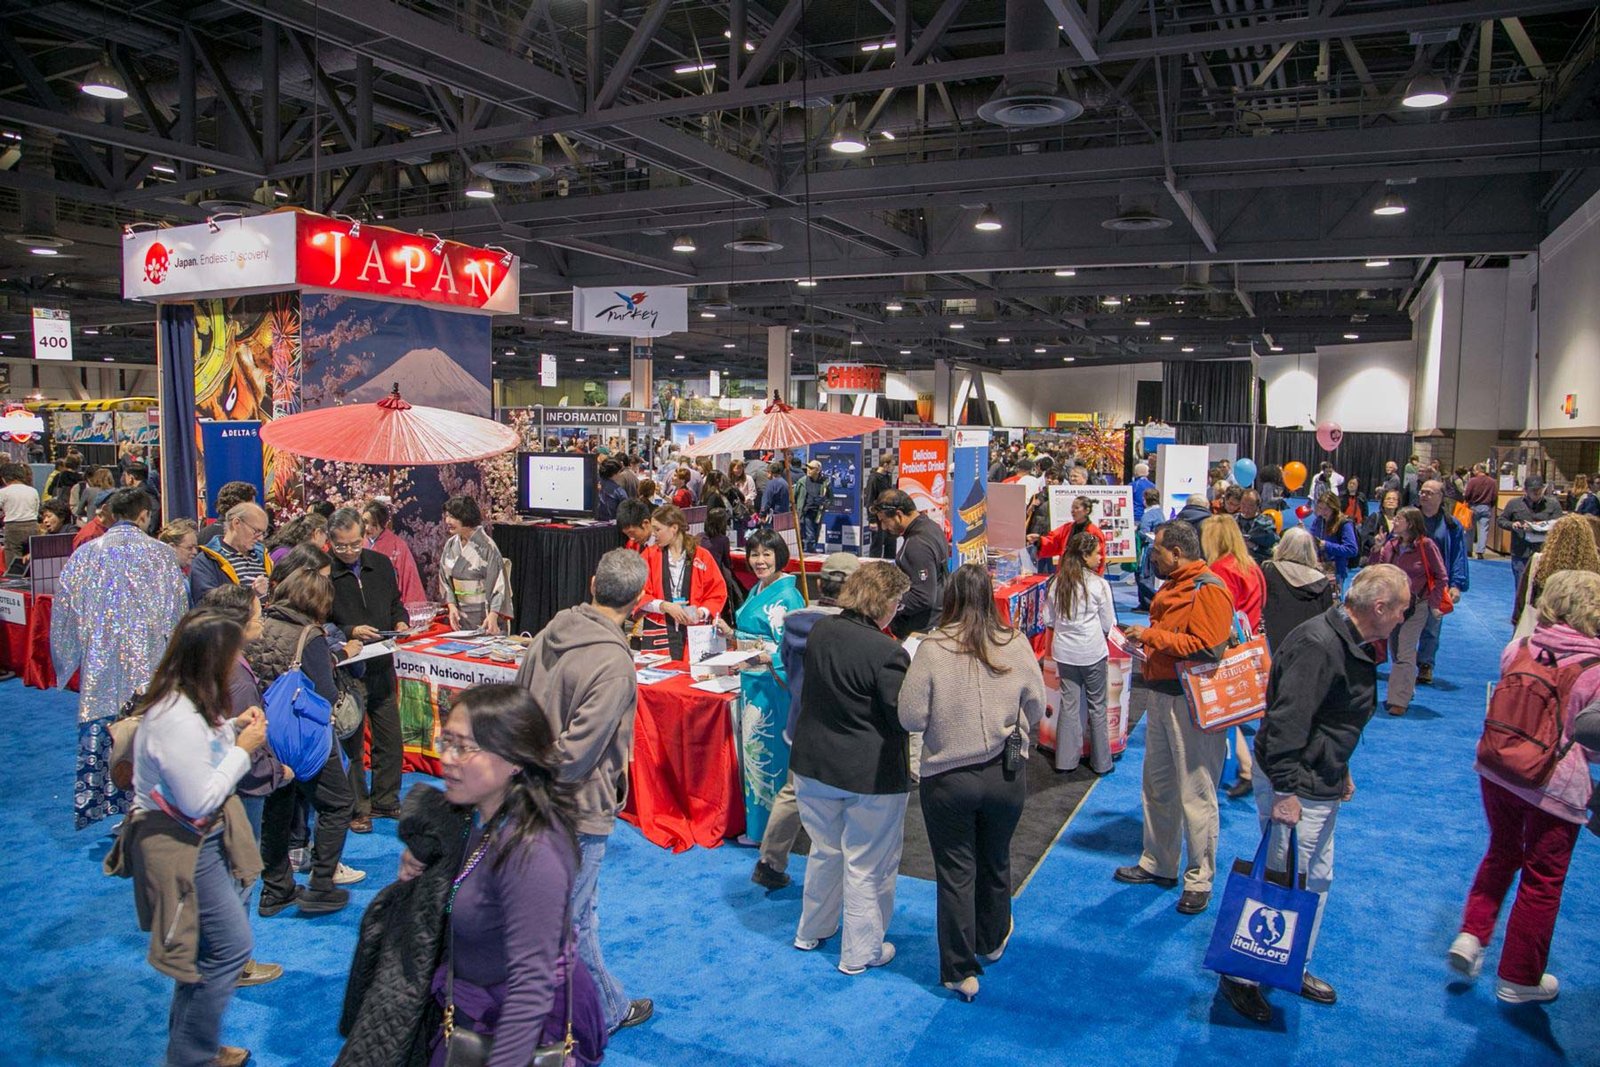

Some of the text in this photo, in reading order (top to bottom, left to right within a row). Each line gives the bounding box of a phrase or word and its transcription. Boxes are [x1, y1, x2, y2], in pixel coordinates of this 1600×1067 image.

[174, 257, 198, 269] Japan.
[200, 253, 228, 265] Endless
[330, 230, 495, 299] JAPAN
[595, 304, 658, 329] Turkey
[39, 336, 68, 348] 400
[546, 412, 618, 423] INFORMATION
[228, 429, 251, 437] DELTA
[912, 449, 937, 460] Delicious
[901, 461, 927, 474] Probiotic
[395, 658, 426, 674] Japan
[429, 664, 475, 684] National
[1233, 934, 1289, 963] italia.org
